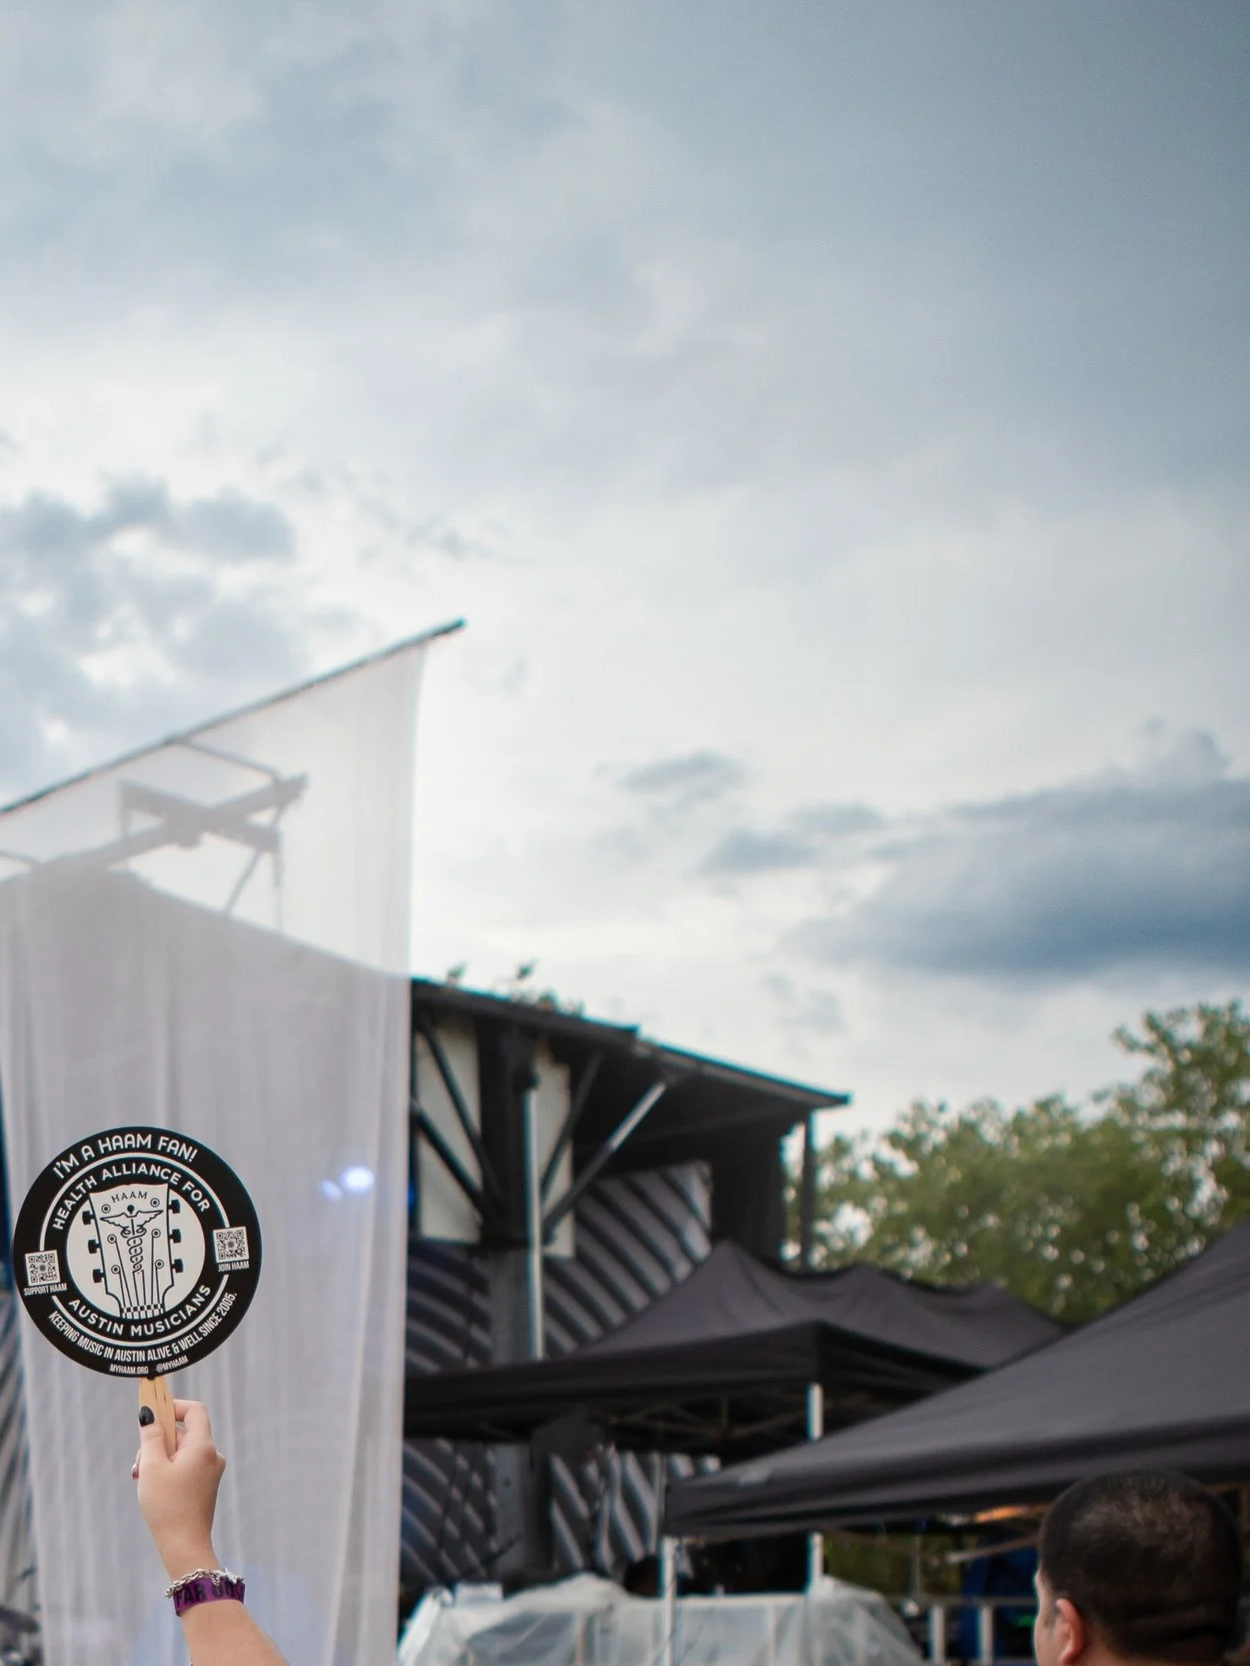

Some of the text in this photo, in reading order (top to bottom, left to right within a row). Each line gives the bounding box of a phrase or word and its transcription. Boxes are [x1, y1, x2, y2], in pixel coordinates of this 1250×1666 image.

[53, 1133, 198, 1179] I'M A HAAM FAN!
[53, 1162, 211, 1230] HEALTH ALLIANCE FOR
[111, 1190, 148, 1204] HAAM
[218, 1260, 249, 1272] JOIN HAAM
[24, 1283, 67, 1296] SUPPORT HAAM
[49, 1292, 238, 1362] KEEPING MUSIC IN AUSTIN ALIVE & WELL SINCE 2005.
[68, 1285, 211, 1337] AUSTIN MUSICIANS
[110, 1355, 189, 1375] MYHAAM.ORG @MYHAAM
